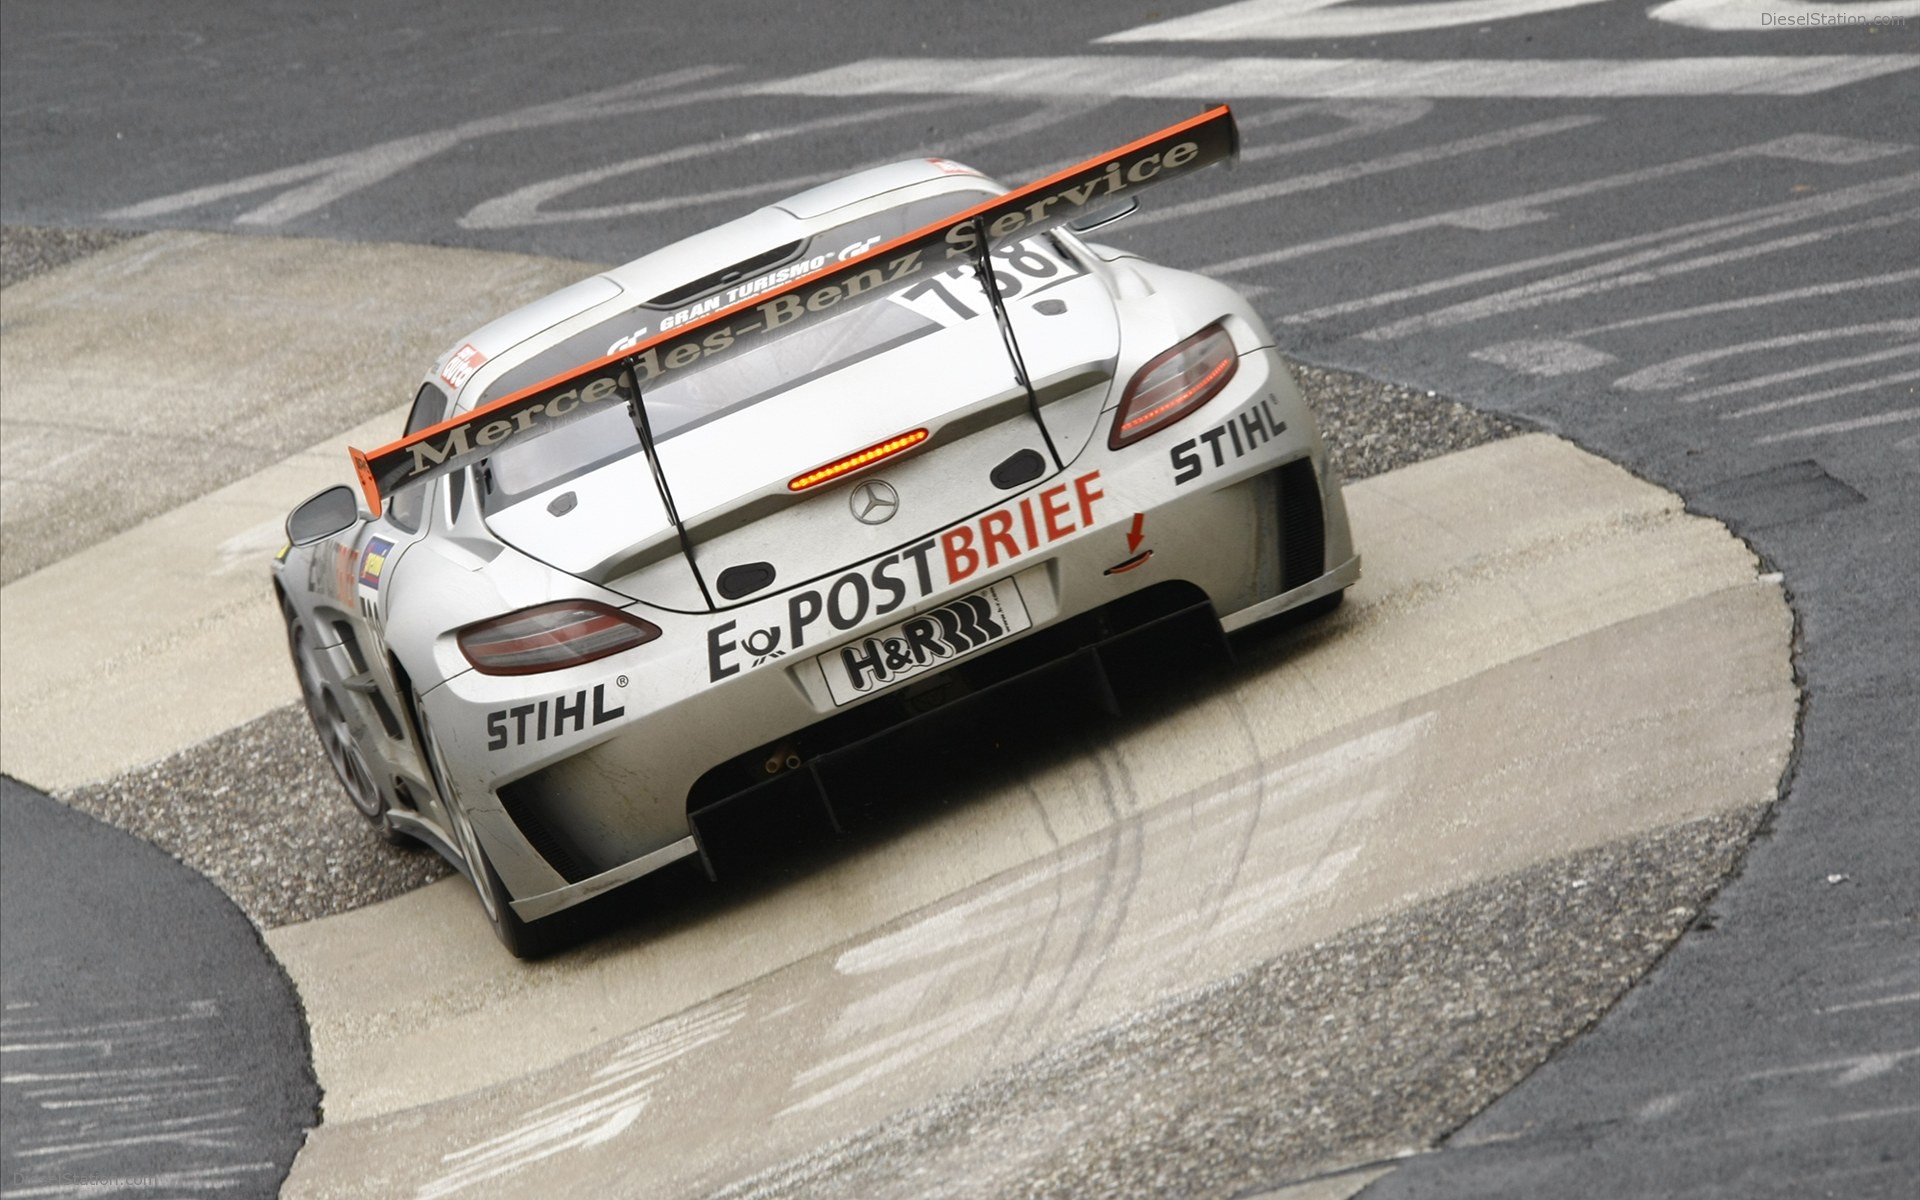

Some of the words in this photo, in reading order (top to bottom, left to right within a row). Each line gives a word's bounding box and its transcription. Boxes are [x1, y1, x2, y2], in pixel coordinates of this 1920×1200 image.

[405, 249, 924, 477] Mercedes-Benz
[945, 141, 1199, 259] Service
[659, 295, 721, 333] GRAN
[726, 253, 827, 304] TURISMO
[1170, 400, 1288, 486] STIHL
[487, 683, 625, 751] STIHL
